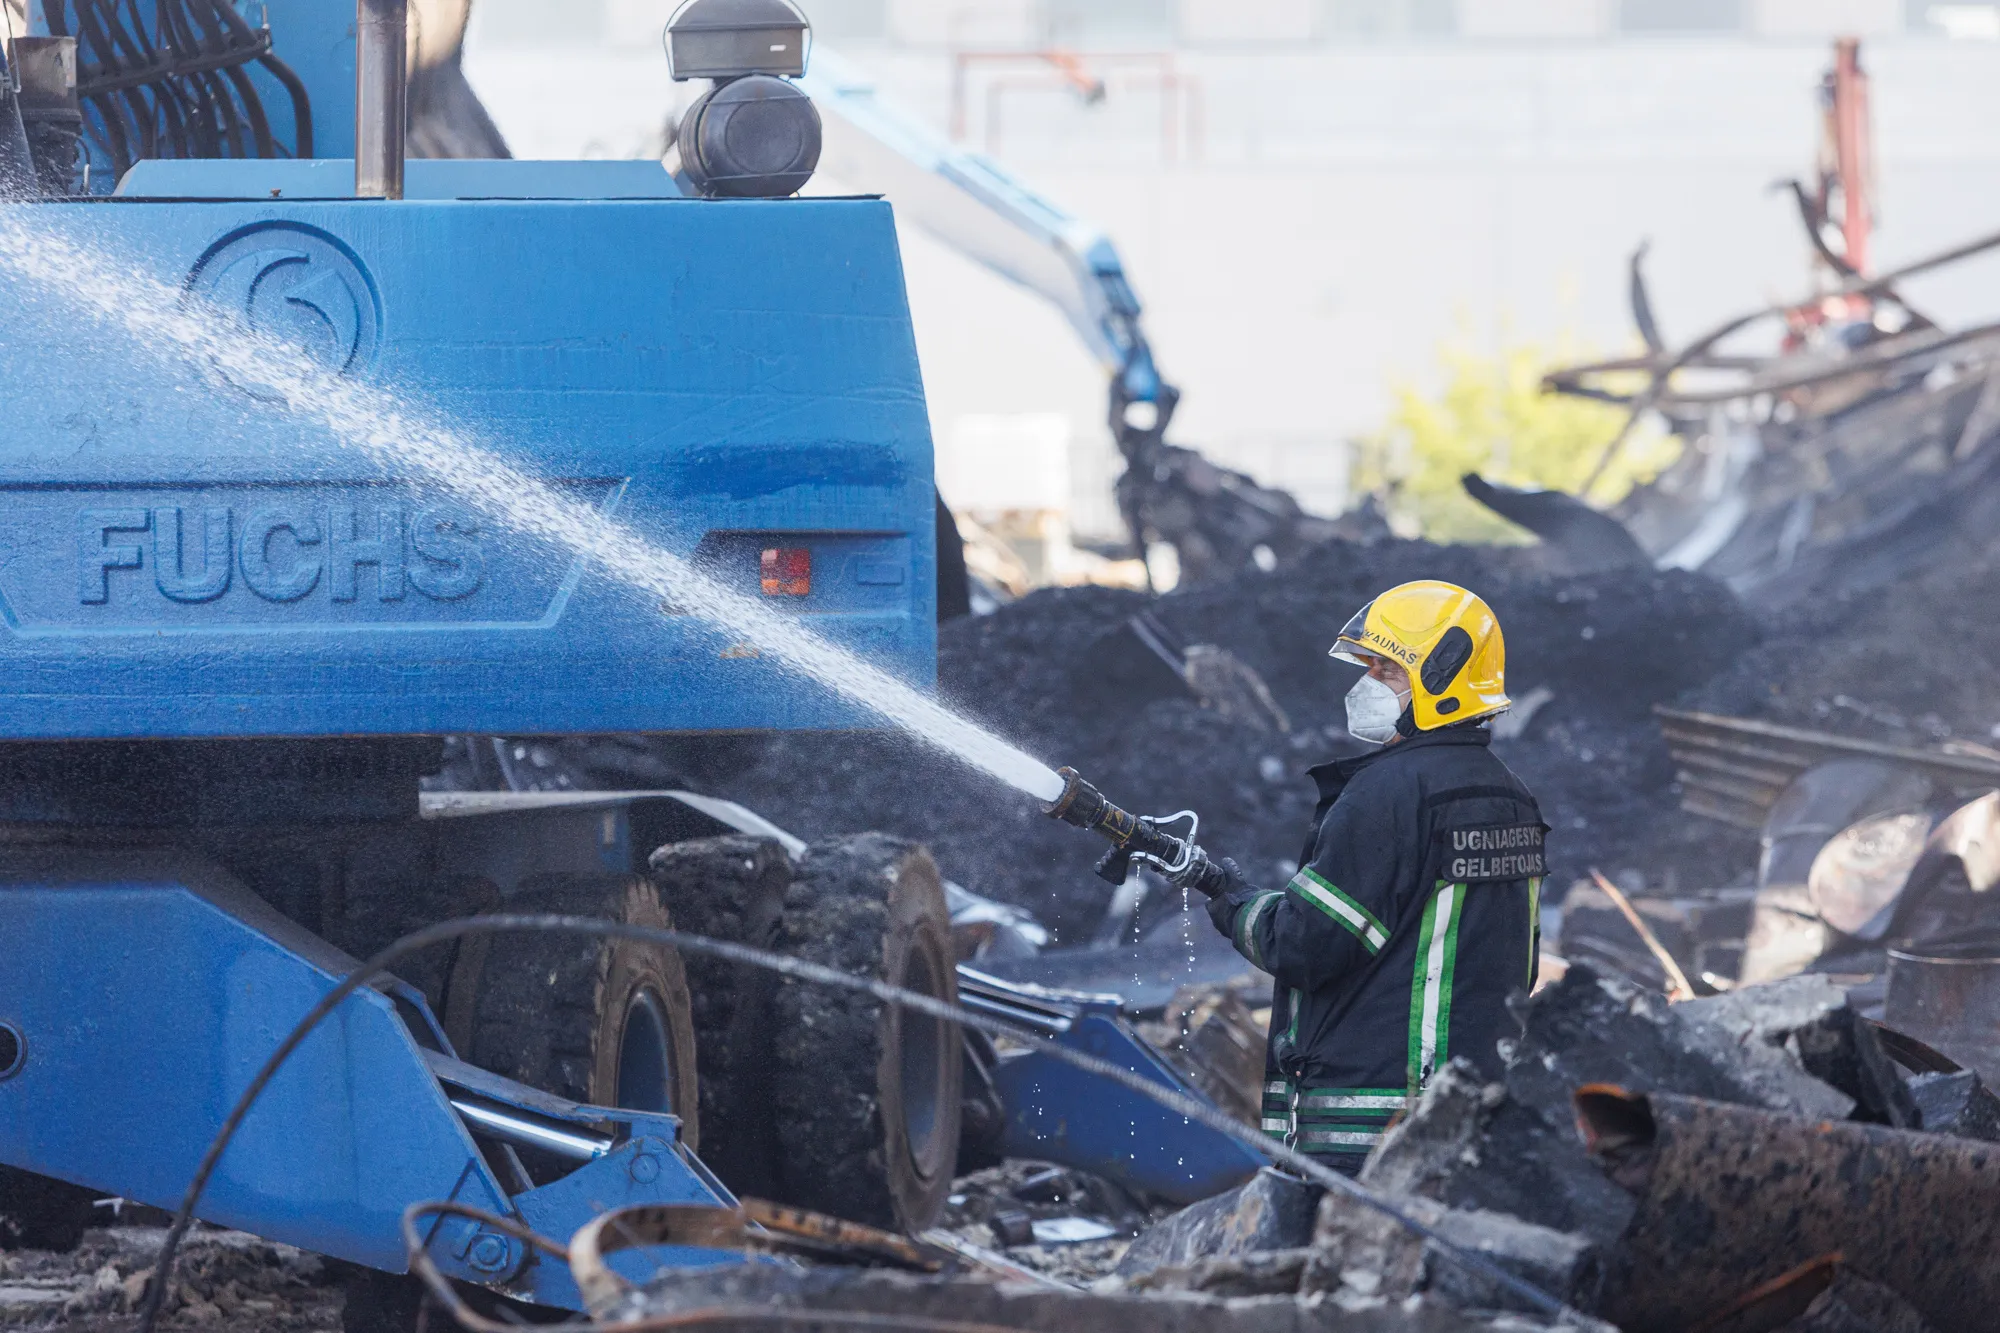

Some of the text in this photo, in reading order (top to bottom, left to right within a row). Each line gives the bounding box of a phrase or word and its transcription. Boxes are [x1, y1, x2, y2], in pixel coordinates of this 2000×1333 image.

[80, 507, 484, 605] FUCHS
[1452, 826, 1542, 851] UGNIAGESYS
[1451, 852, 1543, 878] GELBĖTOJAS
